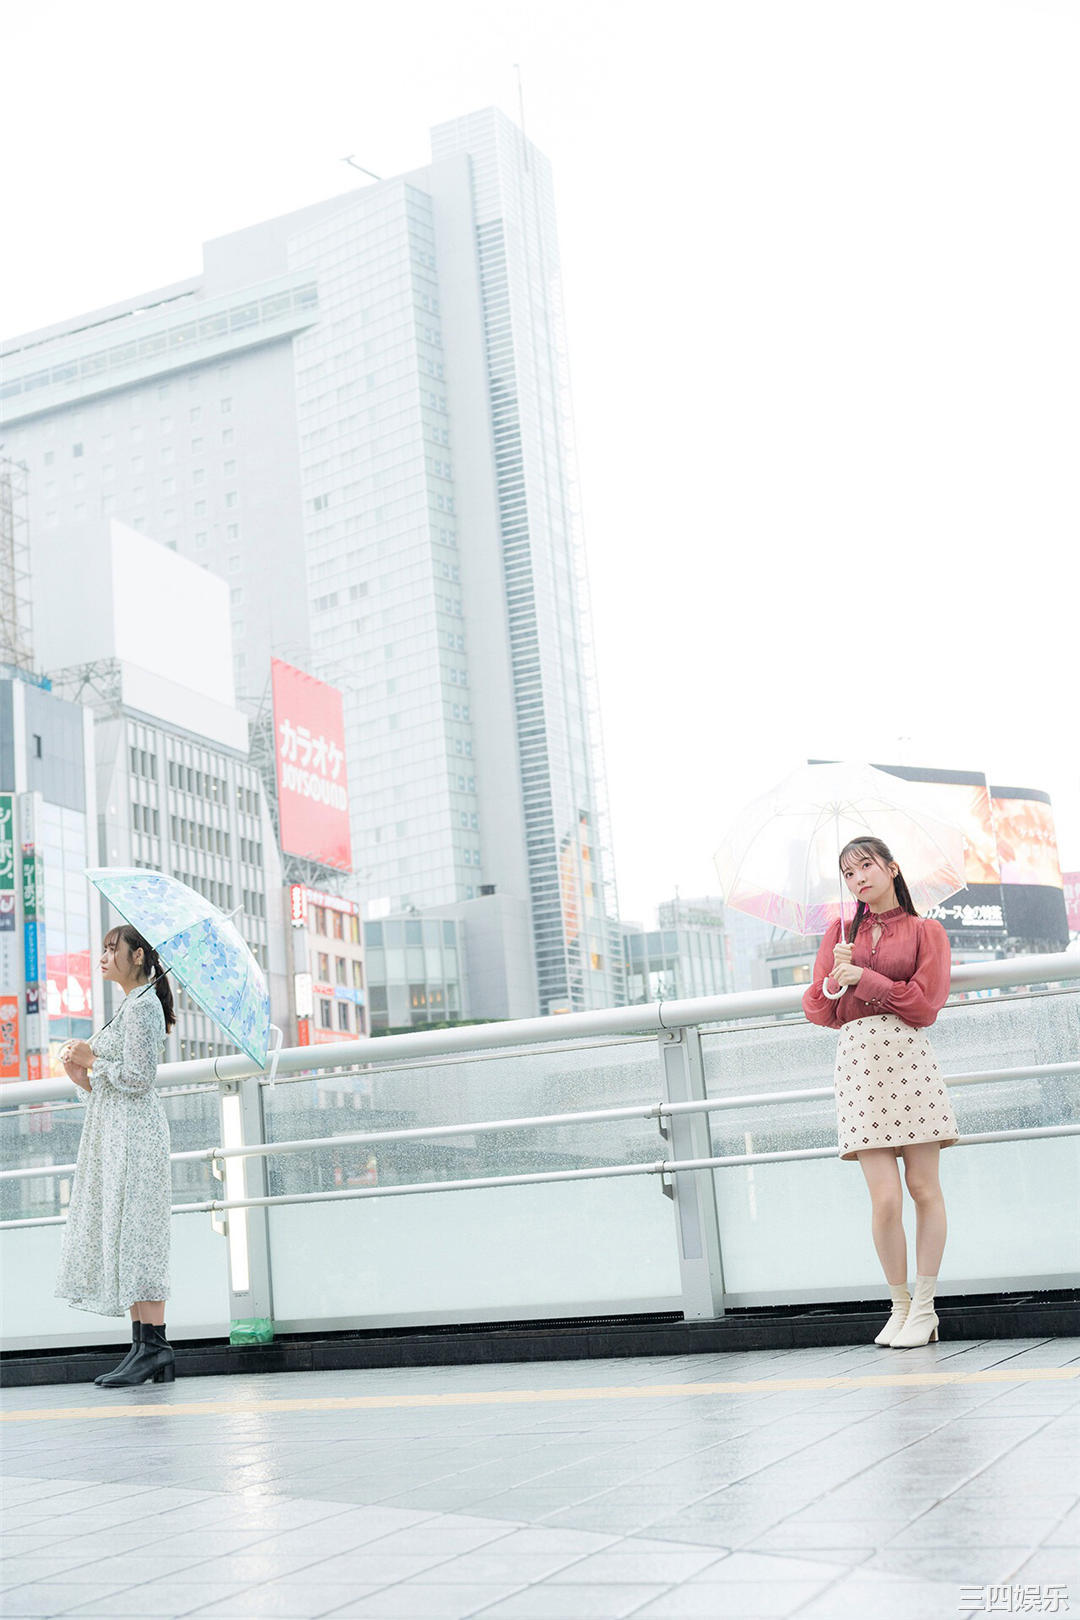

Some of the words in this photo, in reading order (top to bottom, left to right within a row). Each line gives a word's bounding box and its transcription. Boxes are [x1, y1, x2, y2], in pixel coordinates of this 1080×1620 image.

[279, 719, 344, 780] カラオケ
[281, 762, 349, 812] JOYSOUND
